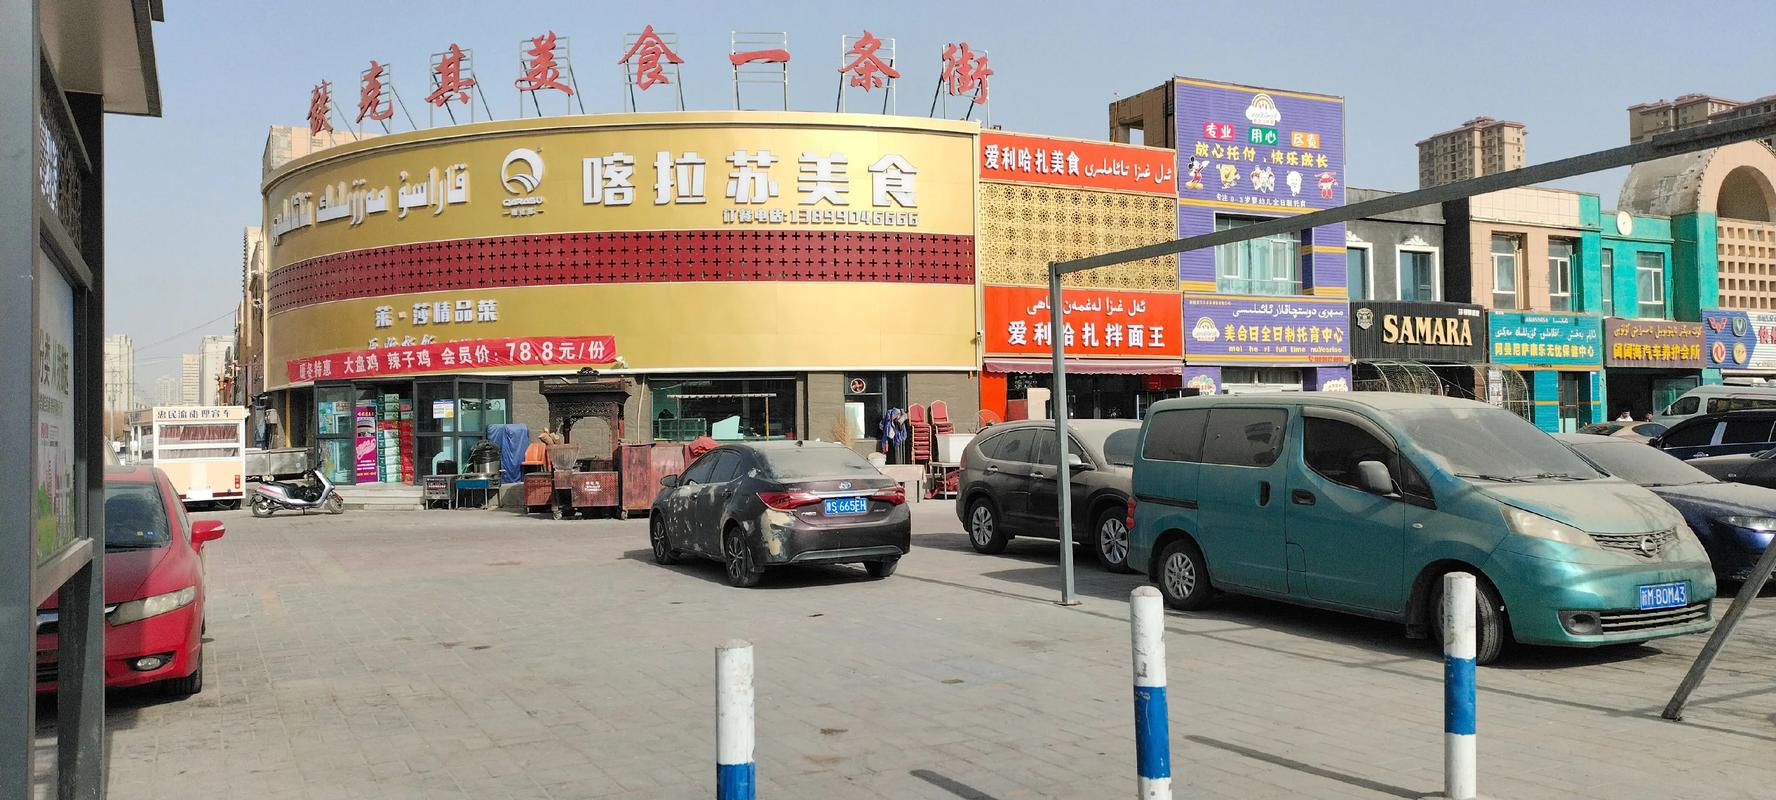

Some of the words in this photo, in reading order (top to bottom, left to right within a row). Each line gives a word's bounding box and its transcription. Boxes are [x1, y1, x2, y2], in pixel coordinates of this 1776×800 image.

[1206, 122, 1232, 138] 专业
[1251, 128, 1276, 144] 用心
[985, 144, 1080, 176] 爱利哈扎美食
[582, 150, 918, 207] 喀拉苏美食
[1224, 323, 1344, 344] 美合日全日制托育中心
[1383, 314, 1473, 346] SAMARA
[344, 354, 379, 374] 大盘鸡
[387, 349, 431, 370] 辣子鸡
